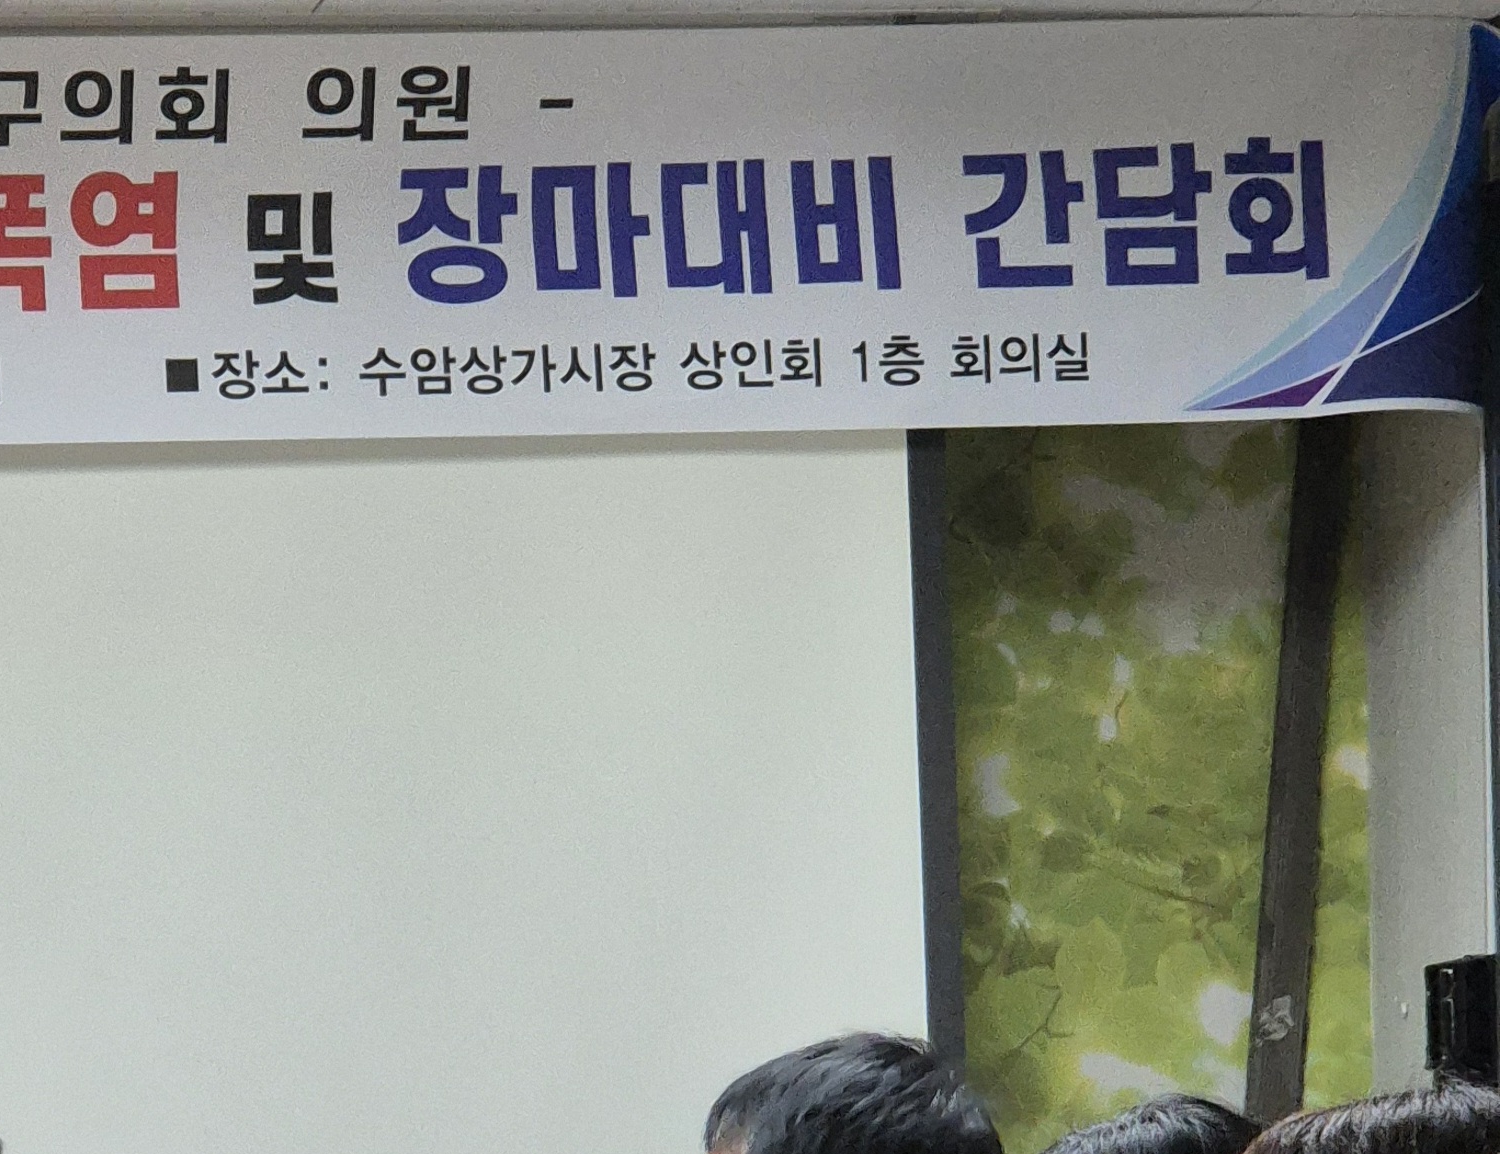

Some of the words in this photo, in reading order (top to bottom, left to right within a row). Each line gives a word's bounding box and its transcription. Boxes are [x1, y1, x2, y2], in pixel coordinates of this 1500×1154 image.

[302, 65, 471, 142] 의원
[246, 191, 339, 305] 및
[397, 155, 902, 305] 장마대비
[962, 136, 1330, 289] 간담회
[212, 349, 329, 400] 장소:
[359, 342, 656, 397] 수암상가시장
[680, 338, 822, 390] 상인회
[852, 335, 925, 387] 1층
[950, 332, 1090, 384] 회의실
